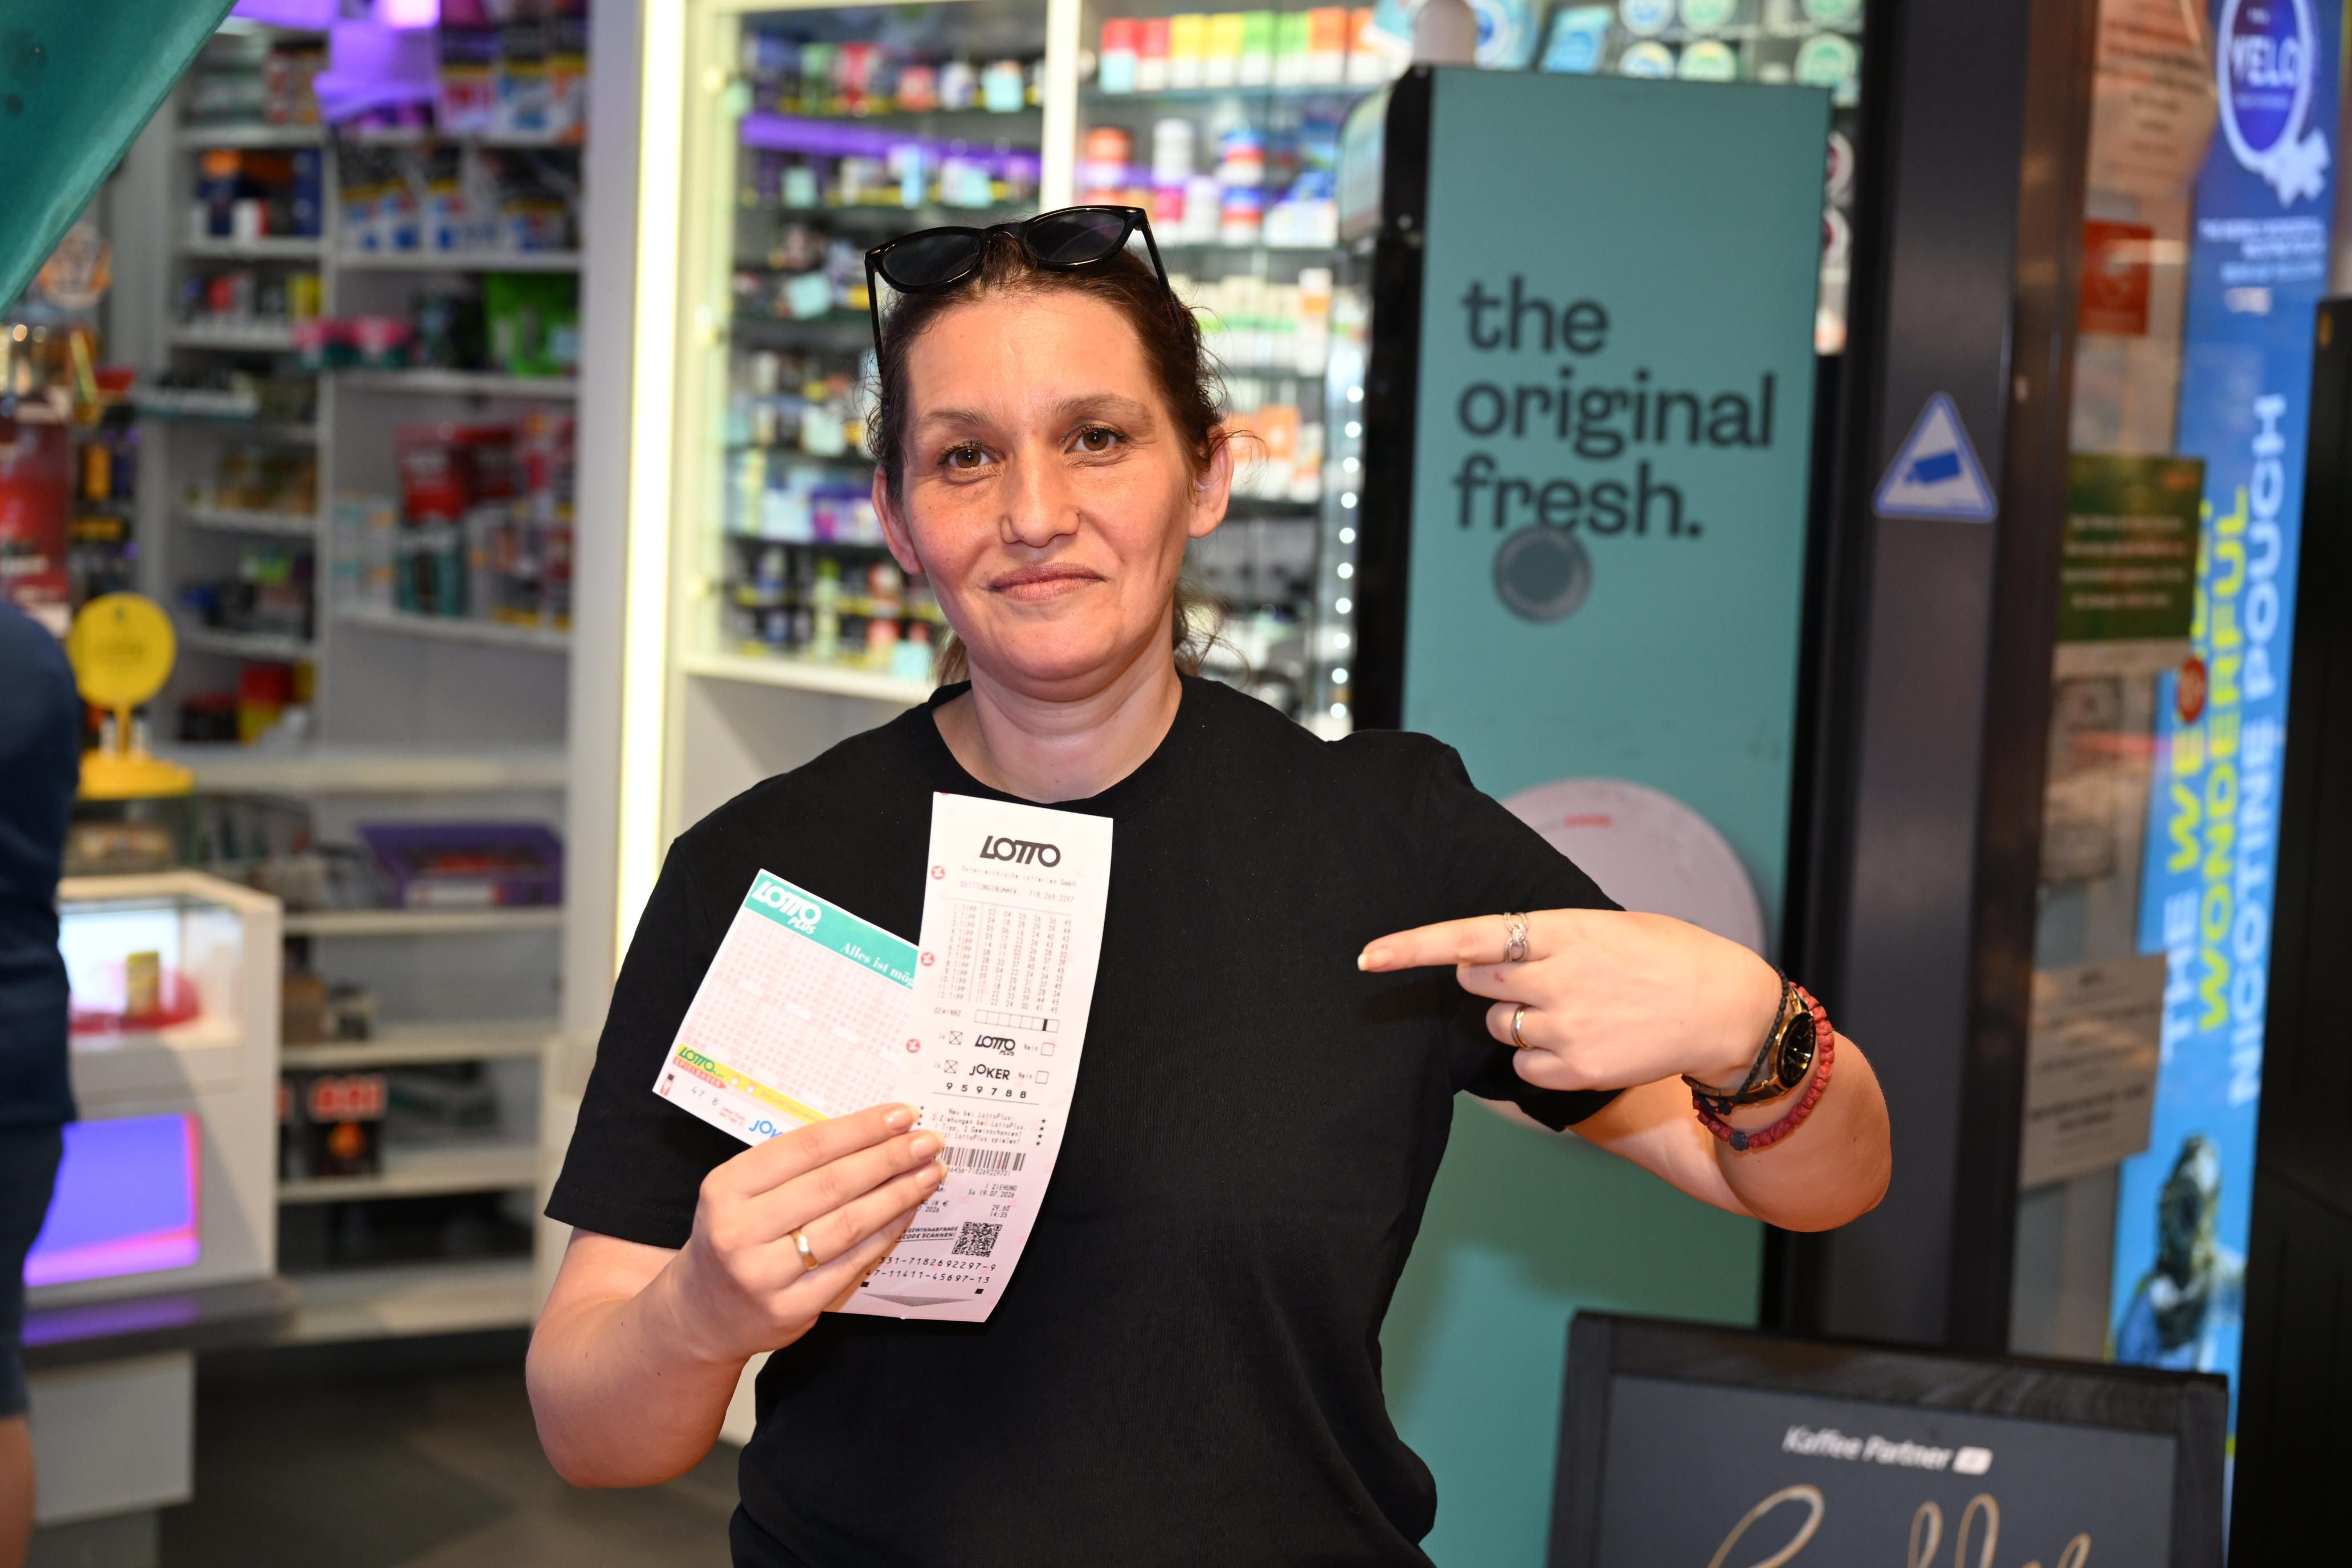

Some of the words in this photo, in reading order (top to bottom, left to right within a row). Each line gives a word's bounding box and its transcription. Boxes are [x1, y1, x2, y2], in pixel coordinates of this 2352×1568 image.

[1459, 275, 1610, 356] the
[1457, 365, 1776, 460] original
[1452, 452, 1702, 539] fresh.
[2243, 394, 2286, 701] POUCH
[2198, 485, 2248, 1032] WONDERFUL
[979, 835, 1061, 867] LOTTO
[752, 880, 822, 925] LOTTO
[787, 918, 816, 934] PLUS
[2227, 716, 2277, 1106] NICOTINE
[840, 942, 871, 964] Alles
[873, 958, 888, 973] ist
[2161, 888, 2200, 1064] THE
[679, 1047, 715, 1072] LOTTO
[974, 1035, 1015, 1051] LOTTO
[969, 1064, 1010, 1080] JOKER
[1782, 1424, 1863, 1460] Kaffee
[1863, 1435, 1954, 1471] Partner
